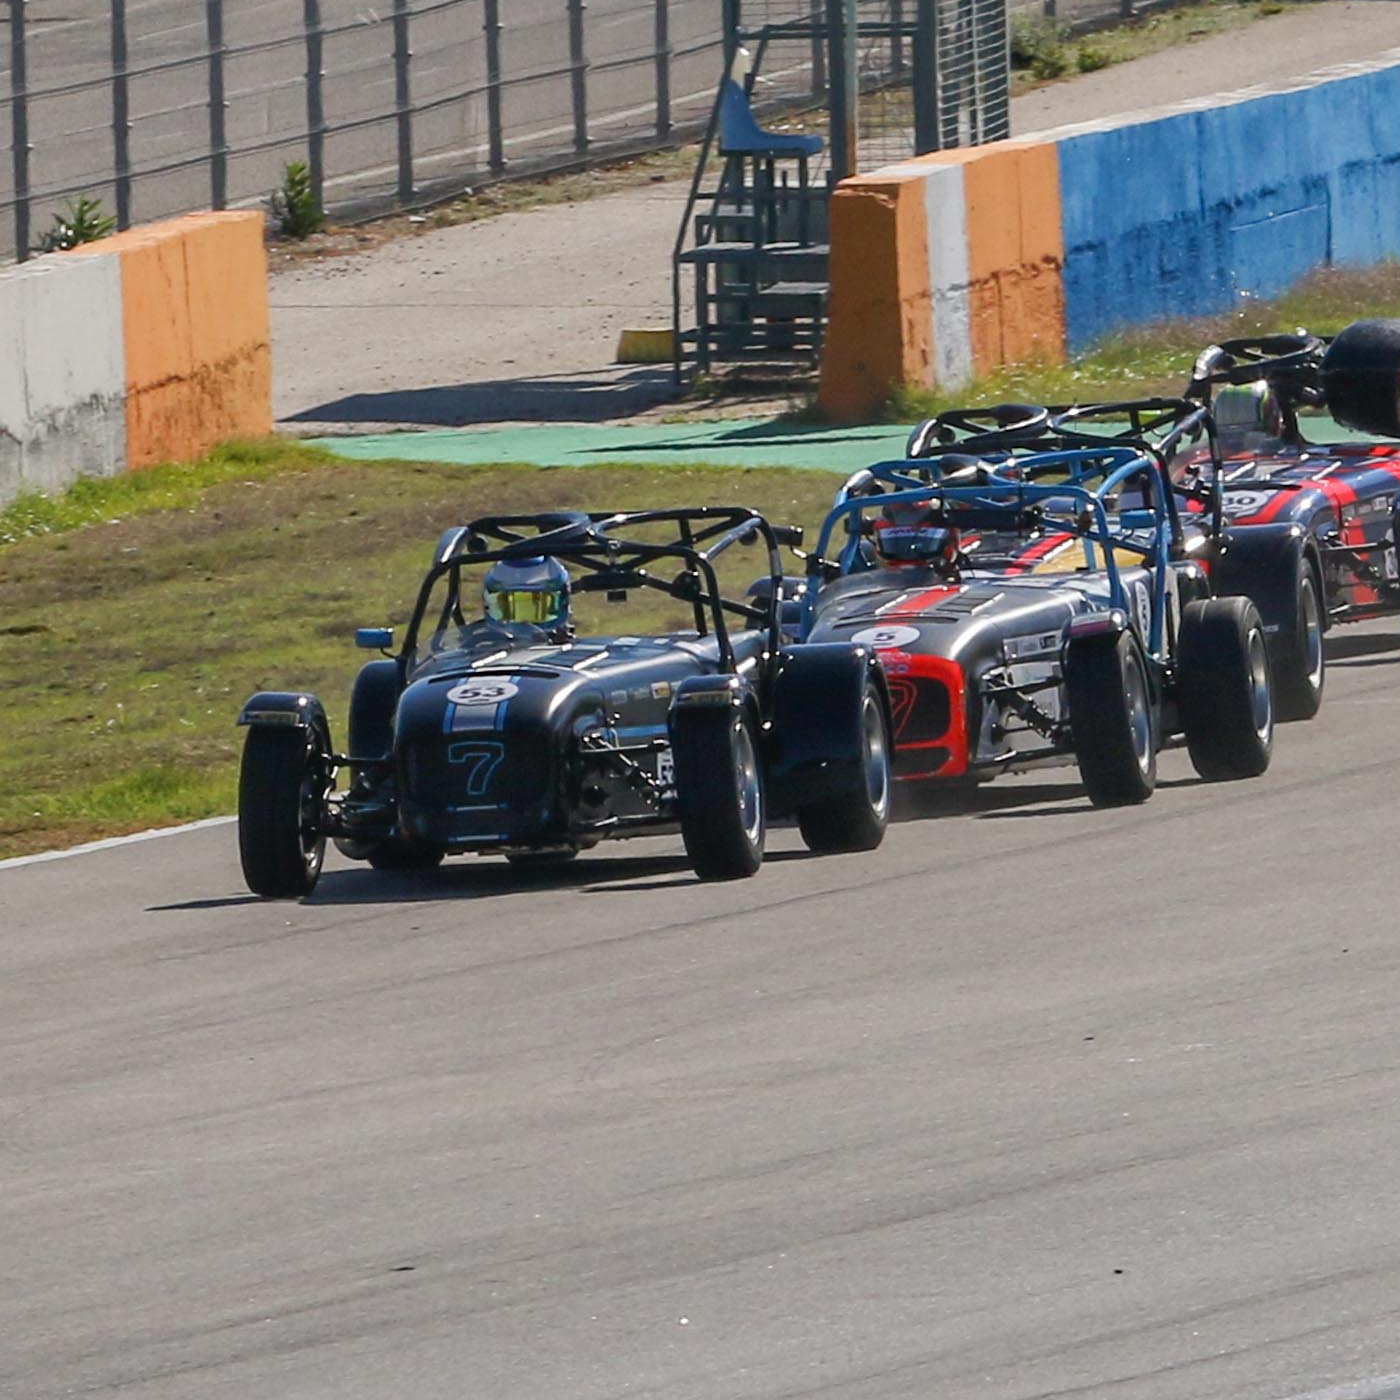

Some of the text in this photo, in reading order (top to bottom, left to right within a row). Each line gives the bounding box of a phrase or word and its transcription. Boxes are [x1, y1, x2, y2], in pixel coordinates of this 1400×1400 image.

[873, 631, 896, 642] 5
[458, 686, 505, 699] 53
[448, 741, 505, 796] 7
